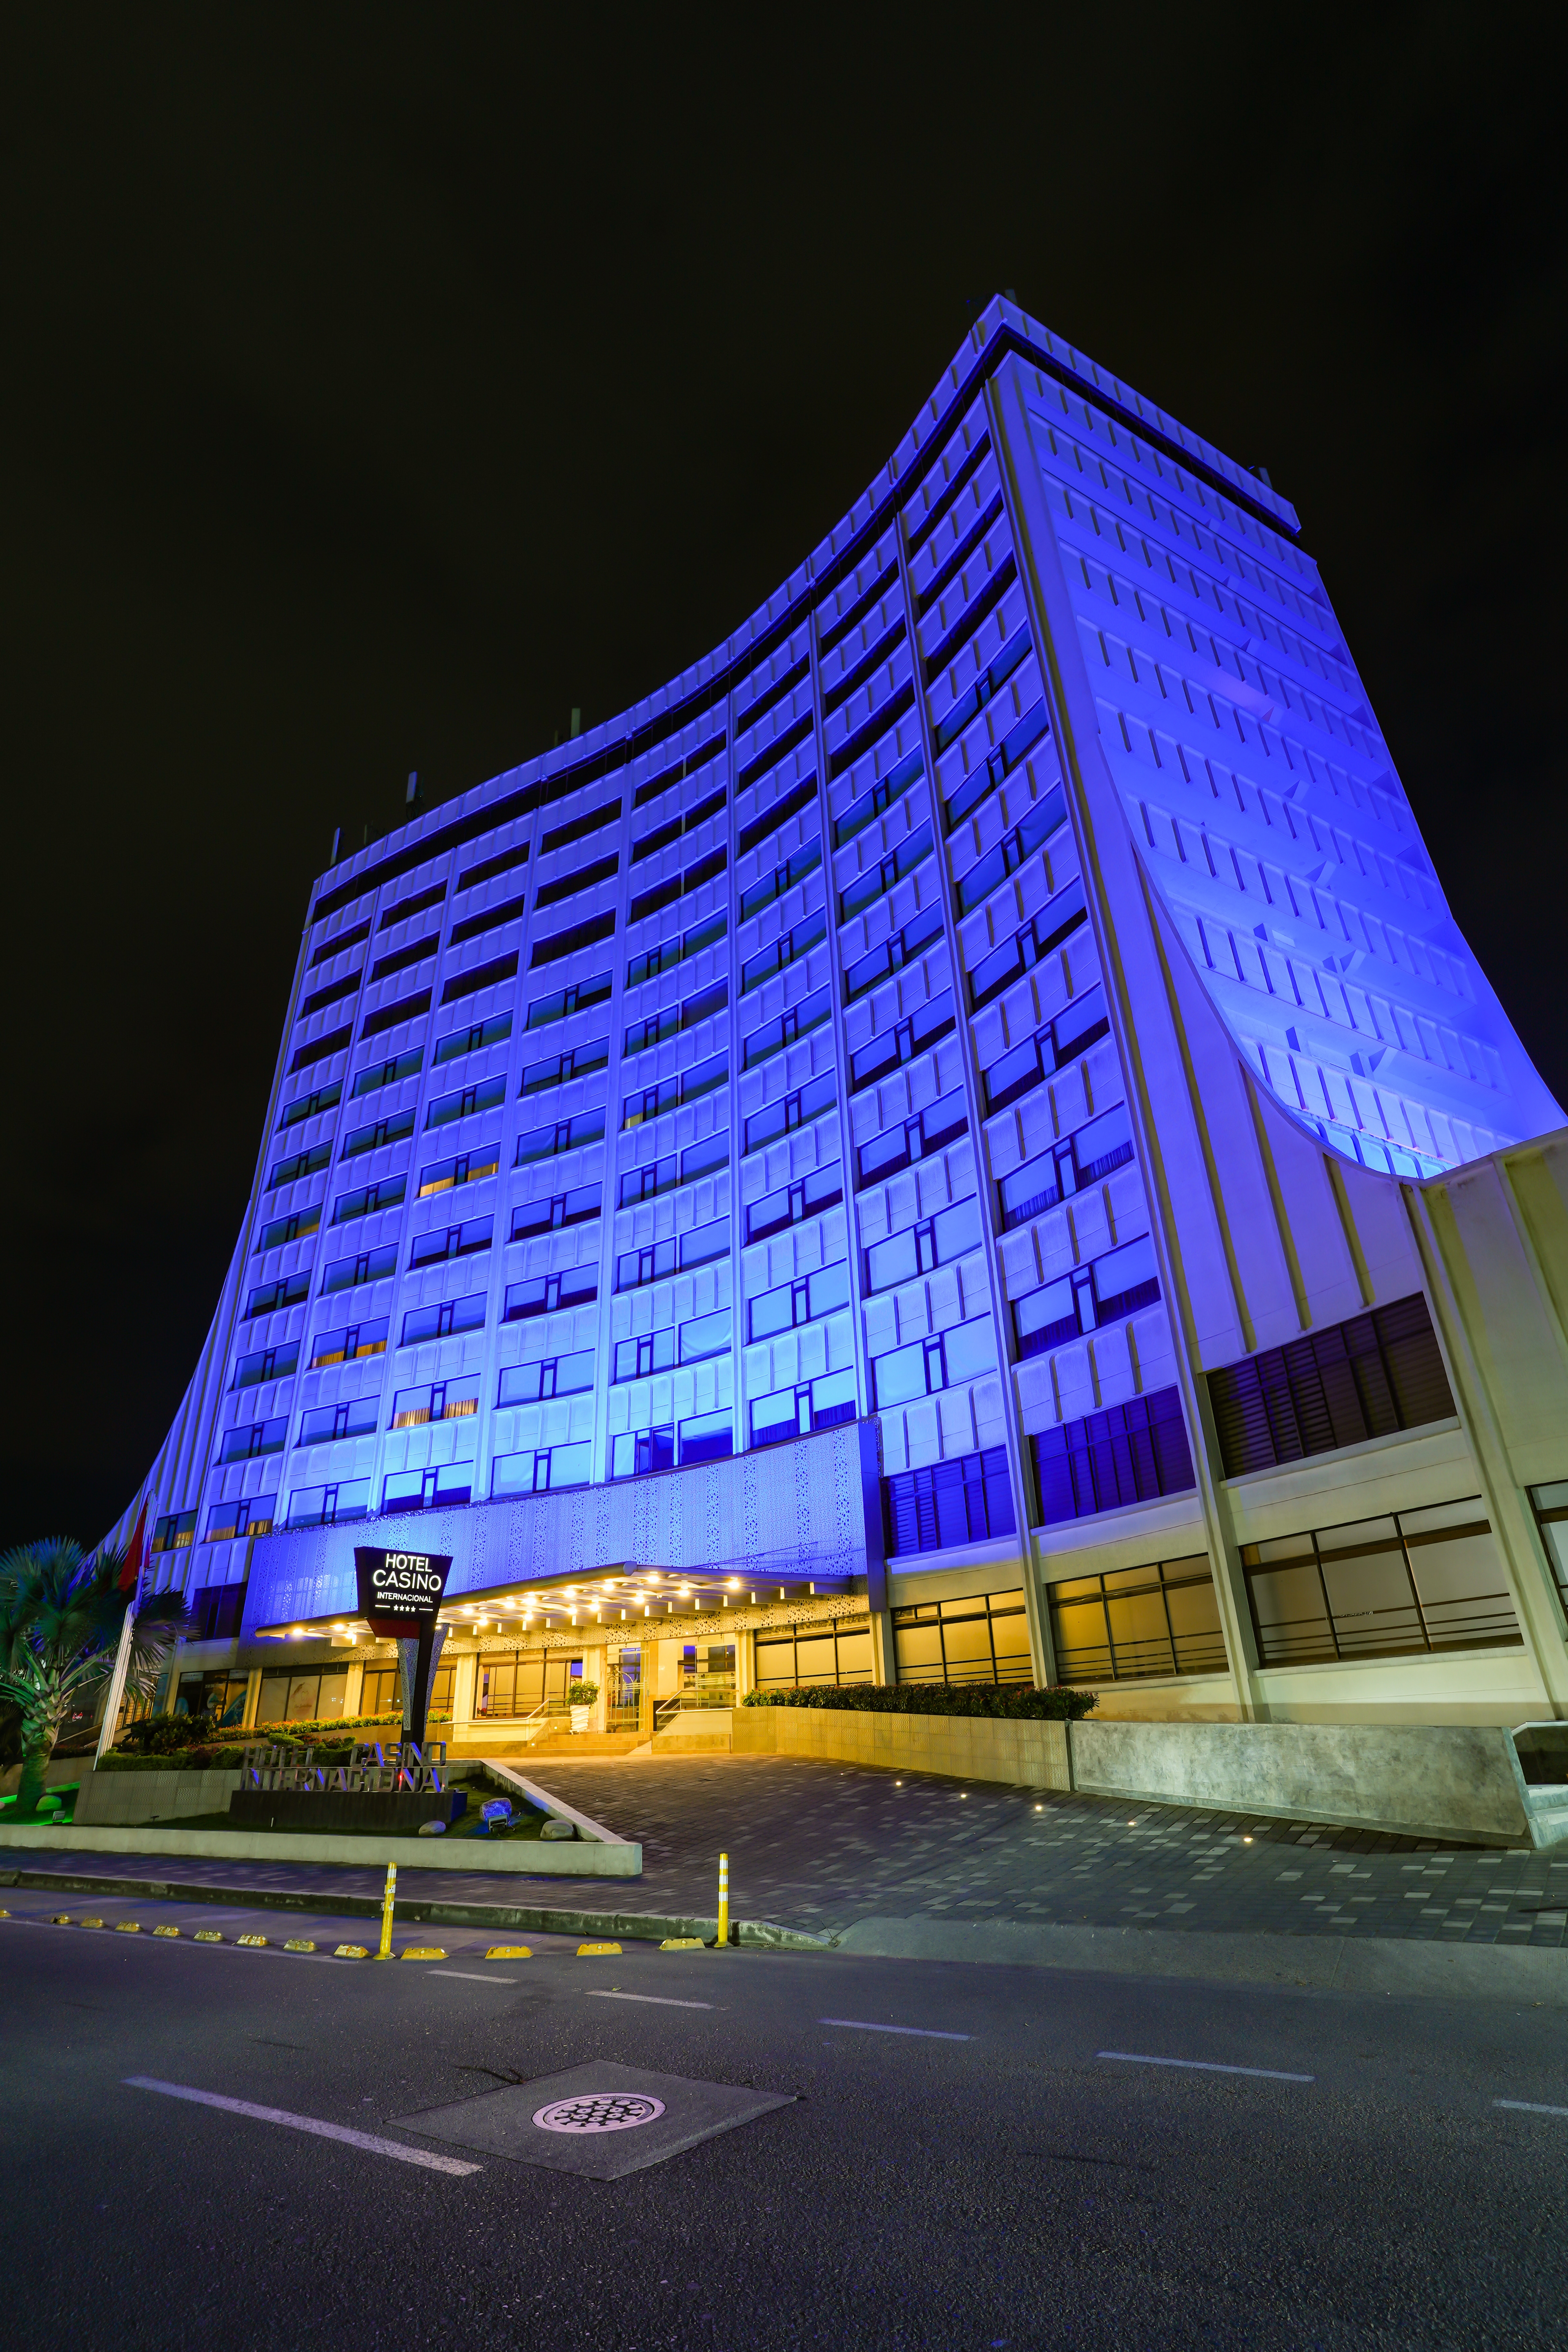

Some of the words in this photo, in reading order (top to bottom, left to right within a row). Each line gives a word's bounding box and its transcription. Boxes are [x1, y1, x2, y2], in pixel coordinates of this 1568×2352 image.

[385, 1553, 432, 1572] HOTEL
[373, 1569, 441, 1591] CASINO
[377, 1591, 433, 1603] INTERNACIONAL
[243, 1744, 320, 1768] HOTEL
[350, 1741, 447, 1767] CASINO
[240, 1767, 457, 1793] INTERNACIONAL
